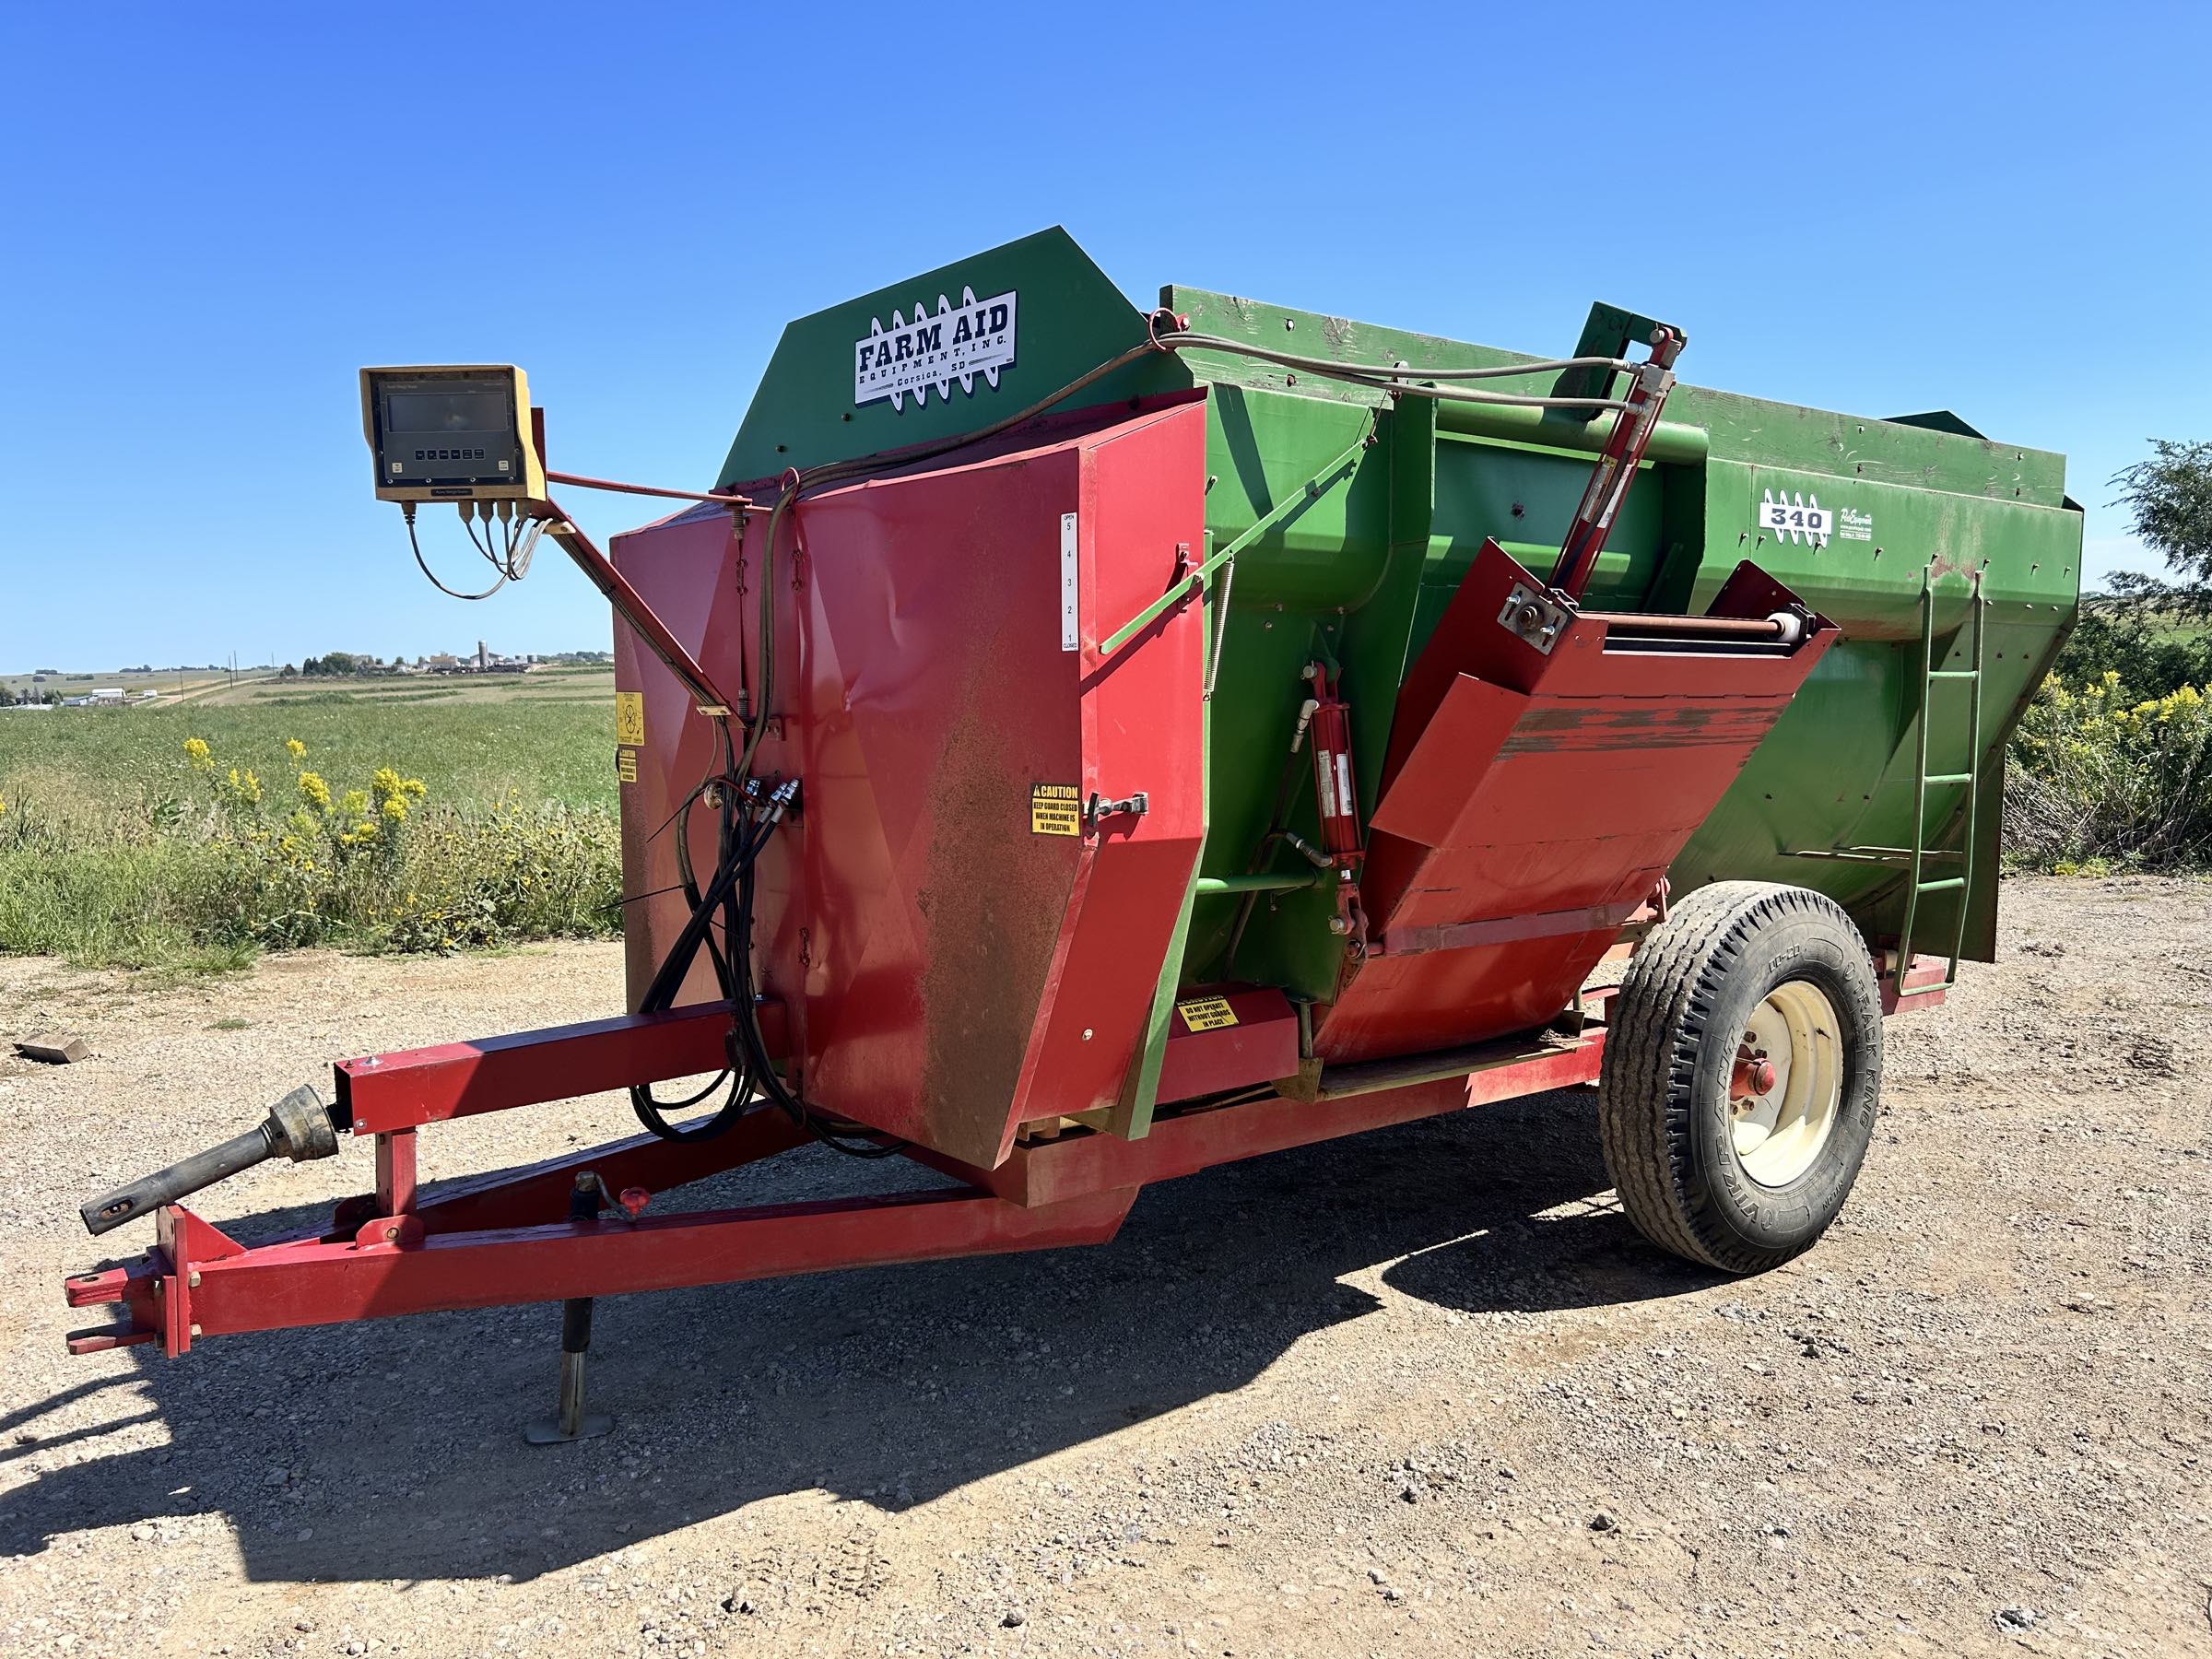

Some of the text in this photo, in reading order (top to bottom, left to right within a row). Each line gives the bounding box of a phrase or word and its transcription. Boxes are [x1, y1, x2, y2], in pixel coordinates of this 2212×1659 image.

[859, 303, 1008, 373] FARM AID
[859, 335, 1006, 384] EQUIPMENT, INC.
[897, 360, 966, 386] Corsica, SD
[1771, 508, 1822, 529] 340
[1066, 522, 1071, 531] 5
[1066, 550, 1071, 559] 4
[1067, 579, 1072, 587] 3
[1067, 606, 1072, 615] 2
[1068, 633, 1072, 642] 1
[1041, 786, 1077, 799] CAUTION
[1060, 804, 1077, 812] CLOSED
[1036, 812, 1076, 822] WHEN MACHINE IS
[1046, 823, 1070, 832] OPERATION
[1194, 1005, 1204, 1013] NOT
[1204, 1002, 1224, 1011] OPERATE
[1187, 1009, 1231, 1022] WITHOUT GUARDS
[1853, 979, 1877, 1129] TRACK KING
